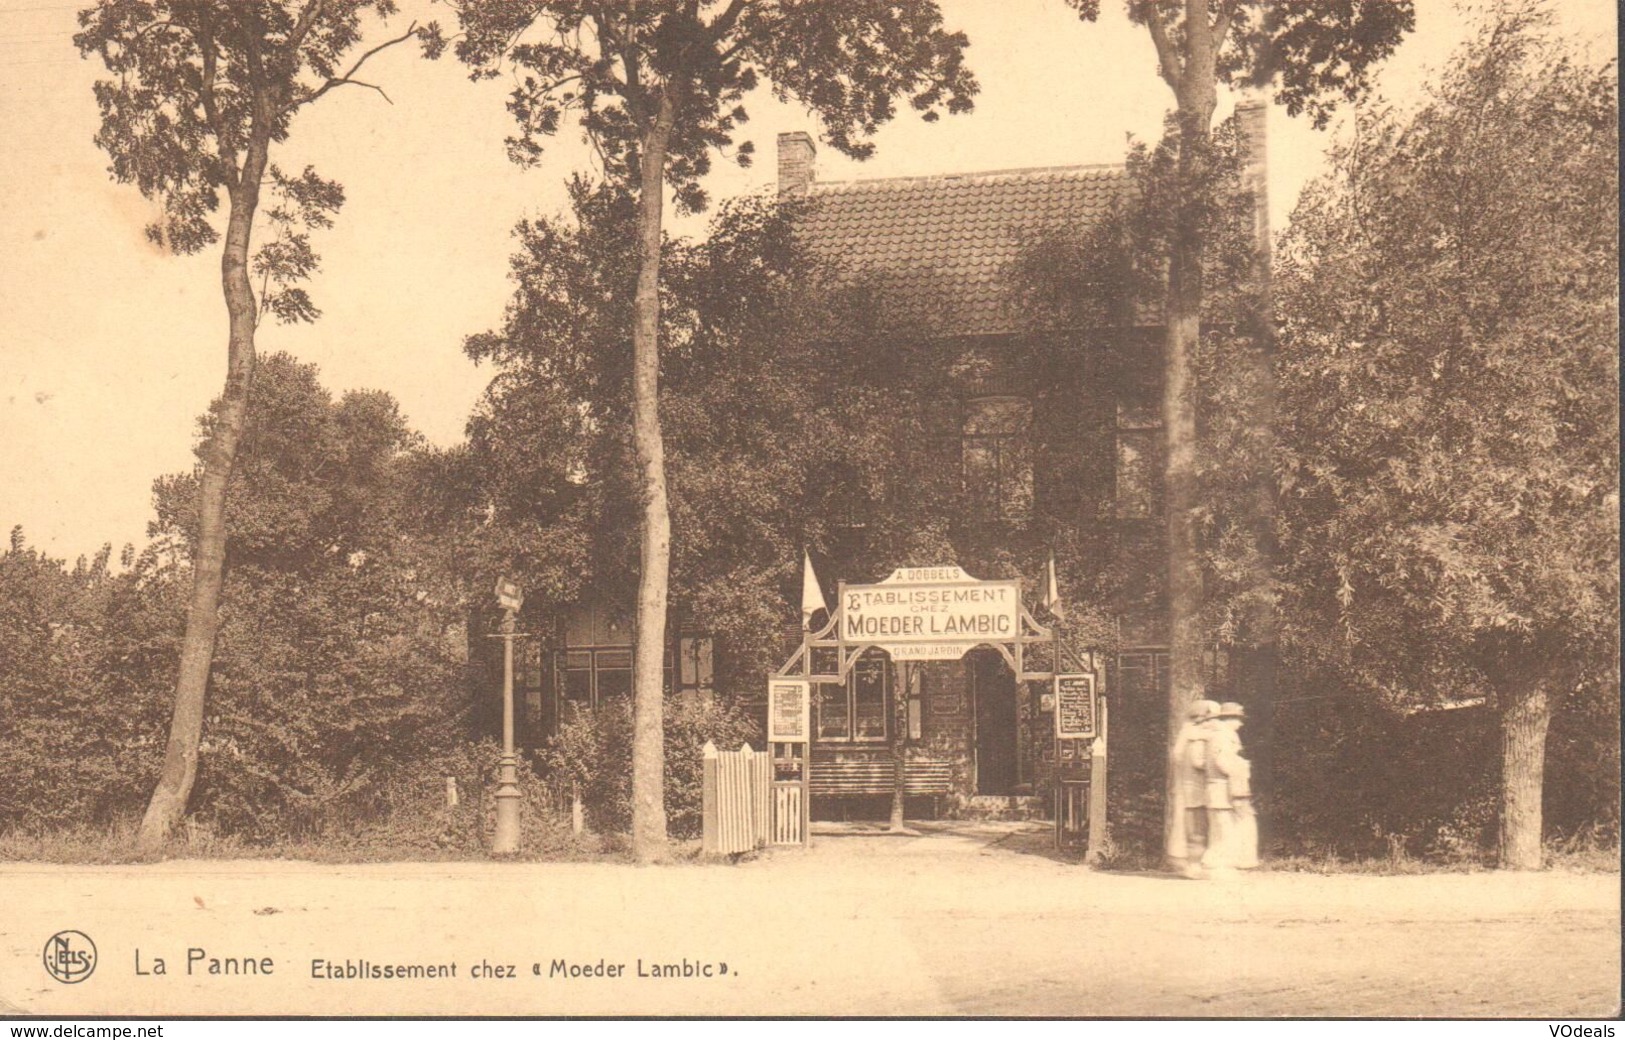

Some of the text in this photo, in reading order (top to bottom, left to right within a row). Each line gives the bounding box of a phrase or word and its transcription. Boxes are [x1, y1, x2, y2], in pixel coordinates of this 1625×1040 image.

[907, 568, 960, 581] DOBBELS
[847, 588, 1007, 611] ETABLISSEMENT
[910, 604, 950, 613] CHEZ
[847, 613, 1010, 635] MOEDER LAMBIC
[893, 645, 963, 656] GRAND JARDIN
